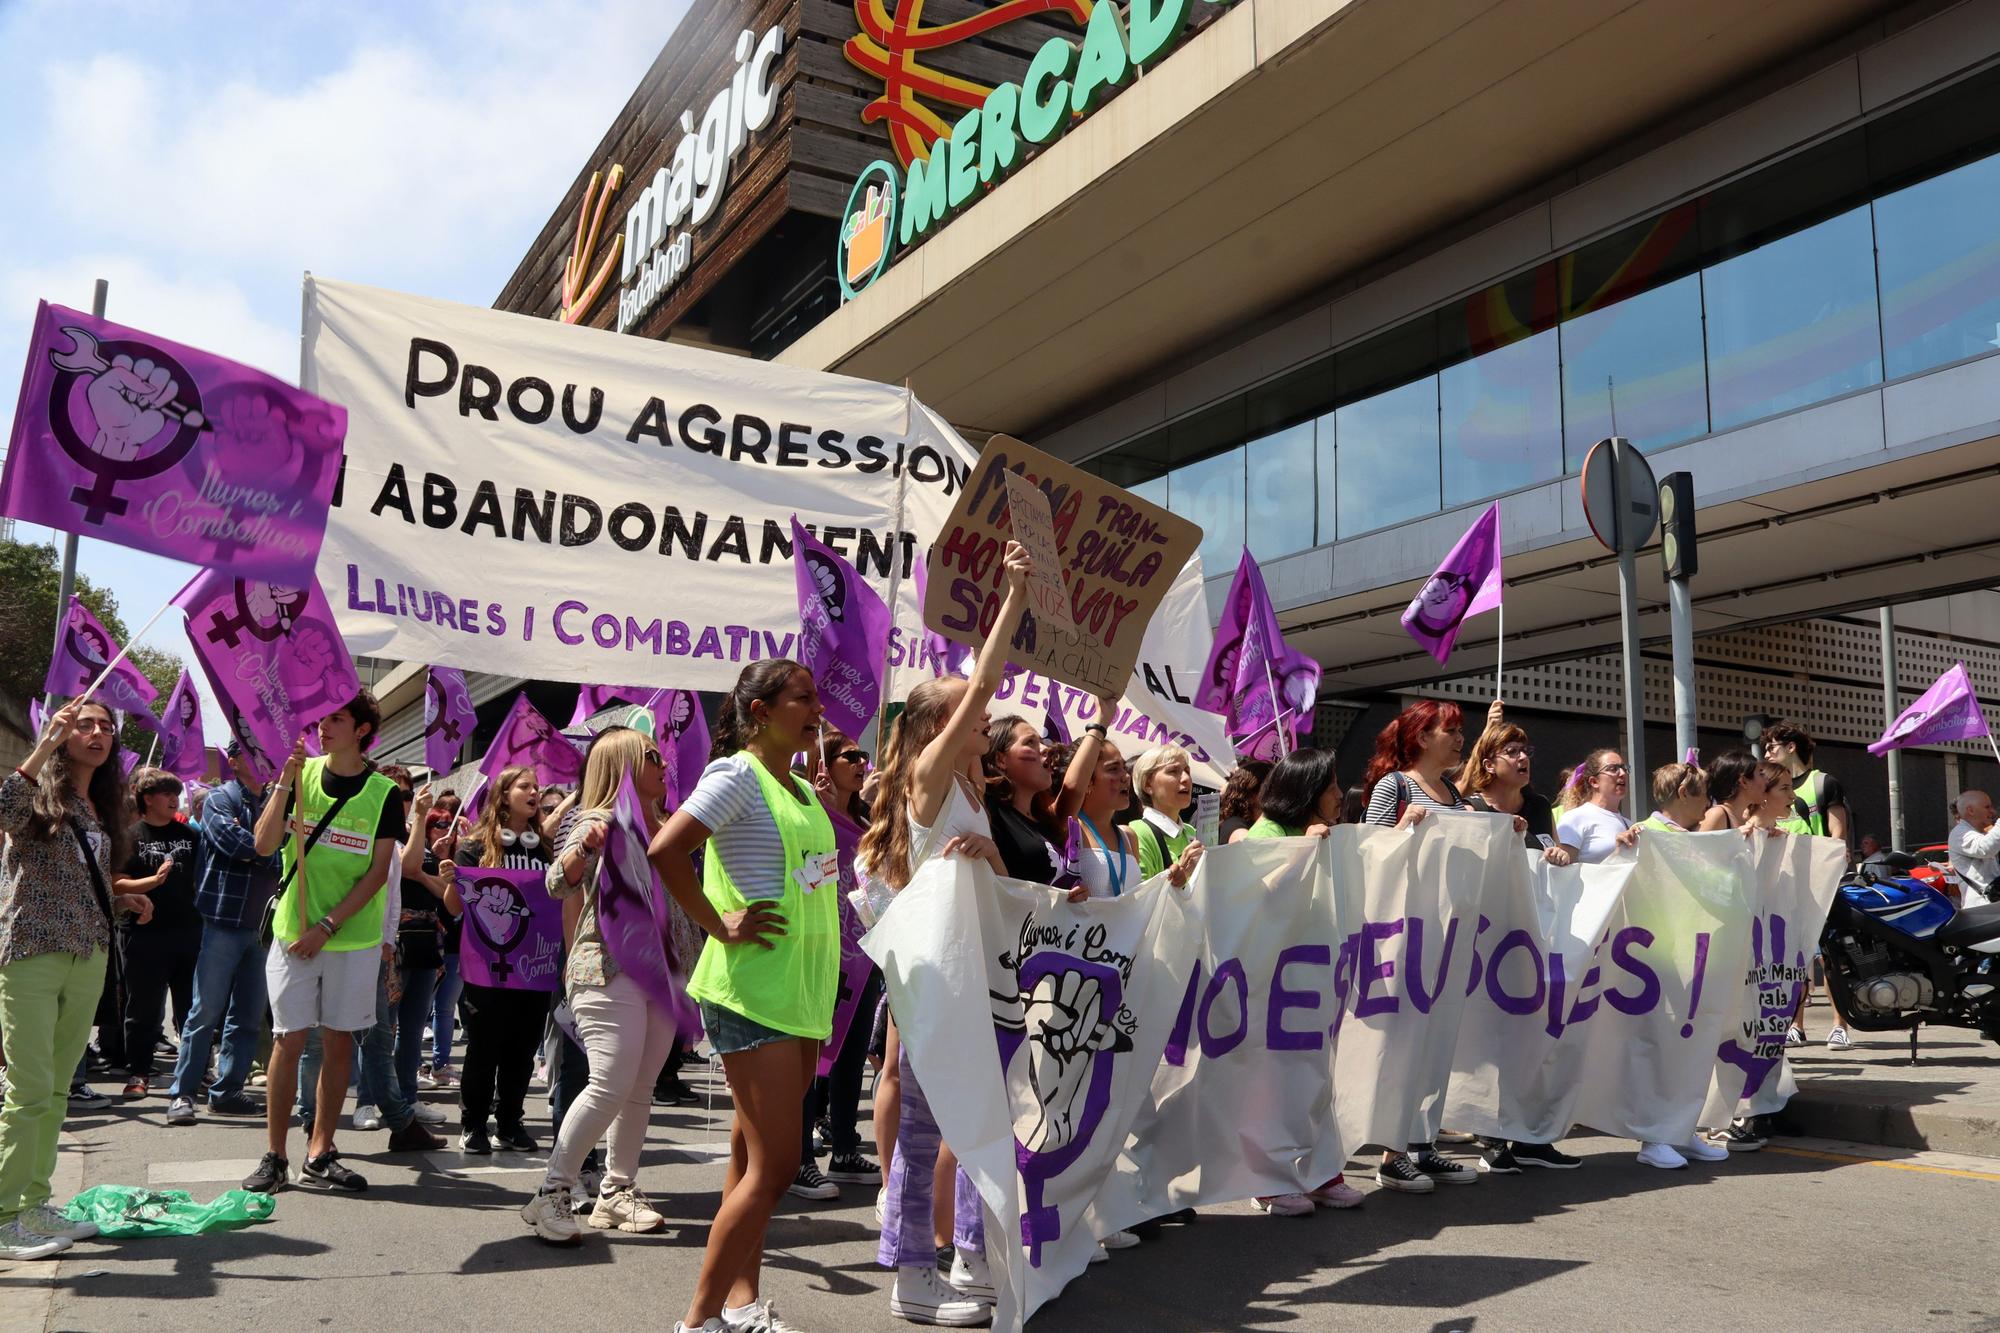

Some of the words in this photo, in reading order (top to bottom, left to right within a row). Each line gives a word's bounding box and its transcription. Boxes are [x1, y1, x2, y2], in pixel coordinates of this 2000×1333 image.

[621, 25, 784, 284] màgic
[900, 0, 1232, 246] MERCAD
[617, 232, 692, 334] badalona
[405, 337, 605, 435] PROU
[626, 396, 971, 496] AGRESSION
[370, 461, 917, 579] ABANDONAMENT
[942, 577, 1037, 656] SOA
[1071, 577, 1138, 648] VOY
[138, 840, 166, 857] DEATH
[168, 839, 192, 850] NOTE
